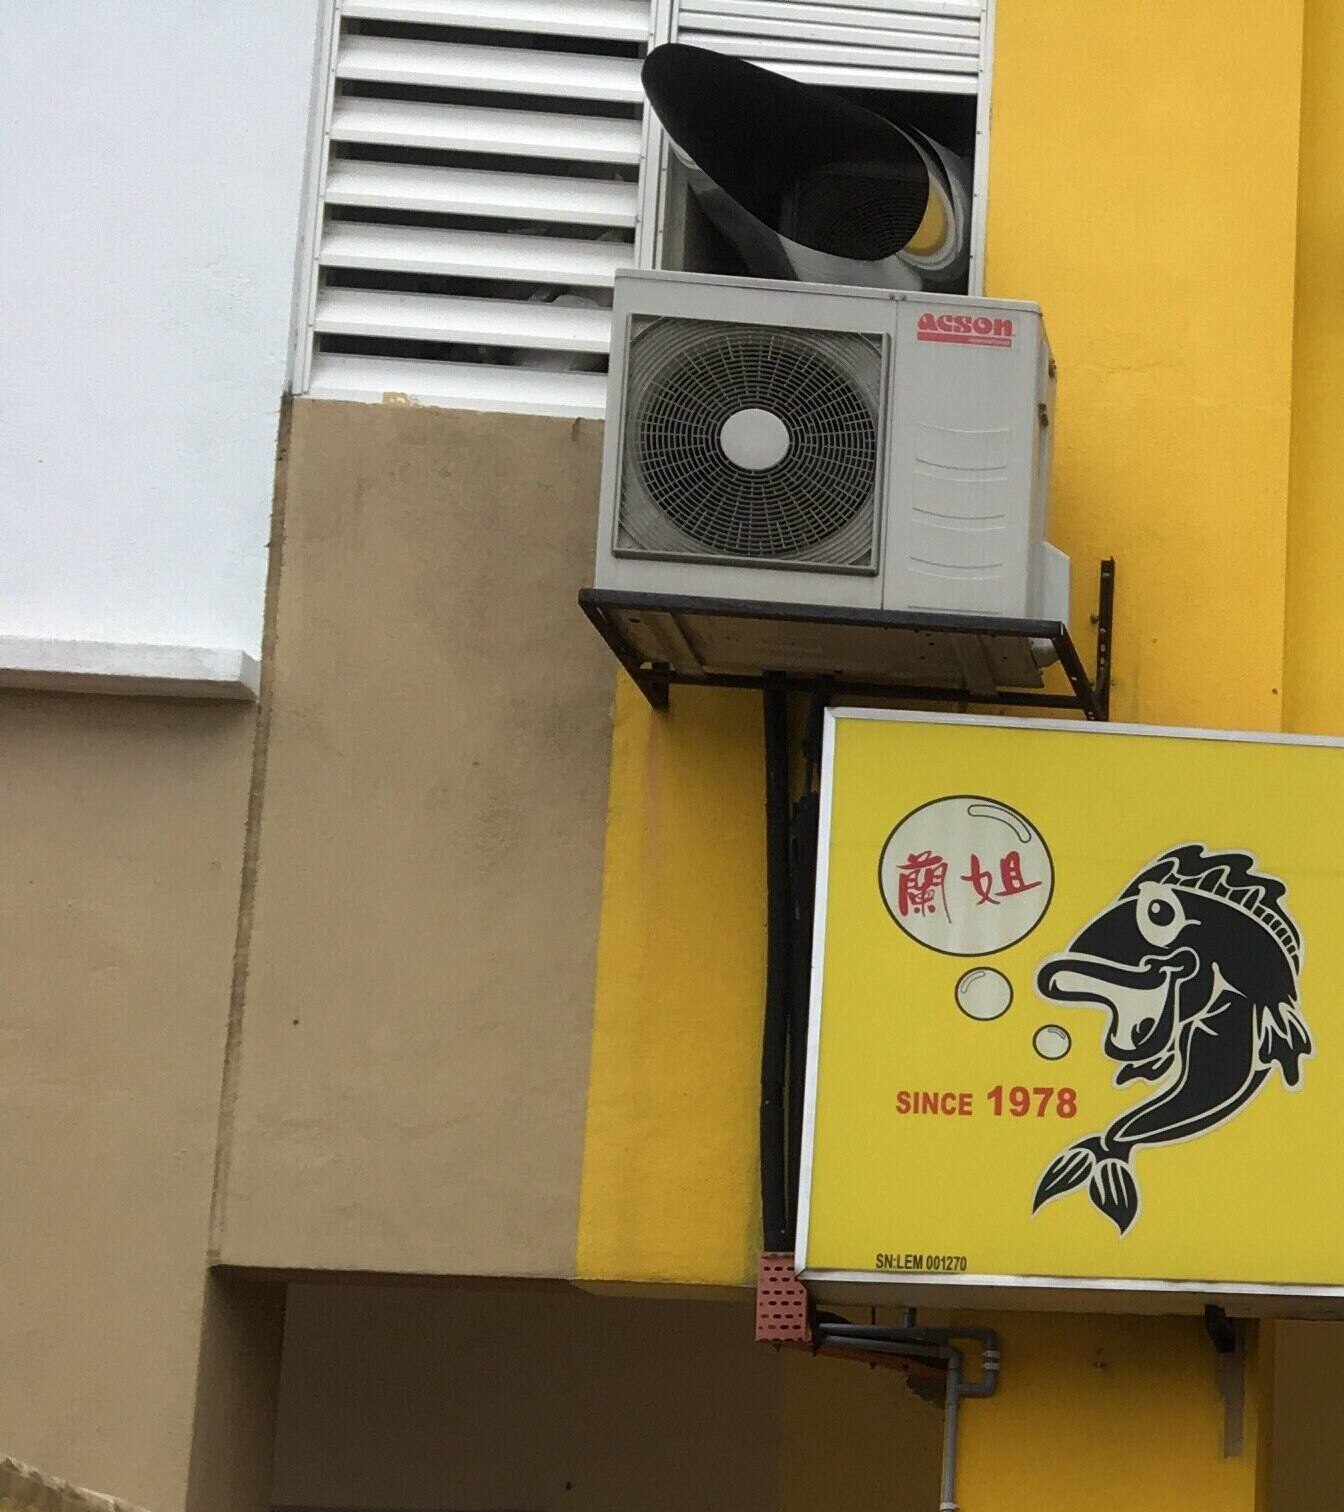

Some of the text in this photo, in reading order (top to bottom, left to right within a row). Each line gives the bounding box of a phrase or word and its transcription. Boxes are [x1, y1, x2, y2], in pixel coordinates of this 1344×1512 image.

[917, 312, 1013, 337] ACSON
[896, 850, 1042, 924] 蘭姐
[895, 1085, 1078, 1119] SINCE 1978
[875, 1253, 967, 1272] SN:LEM 001270
